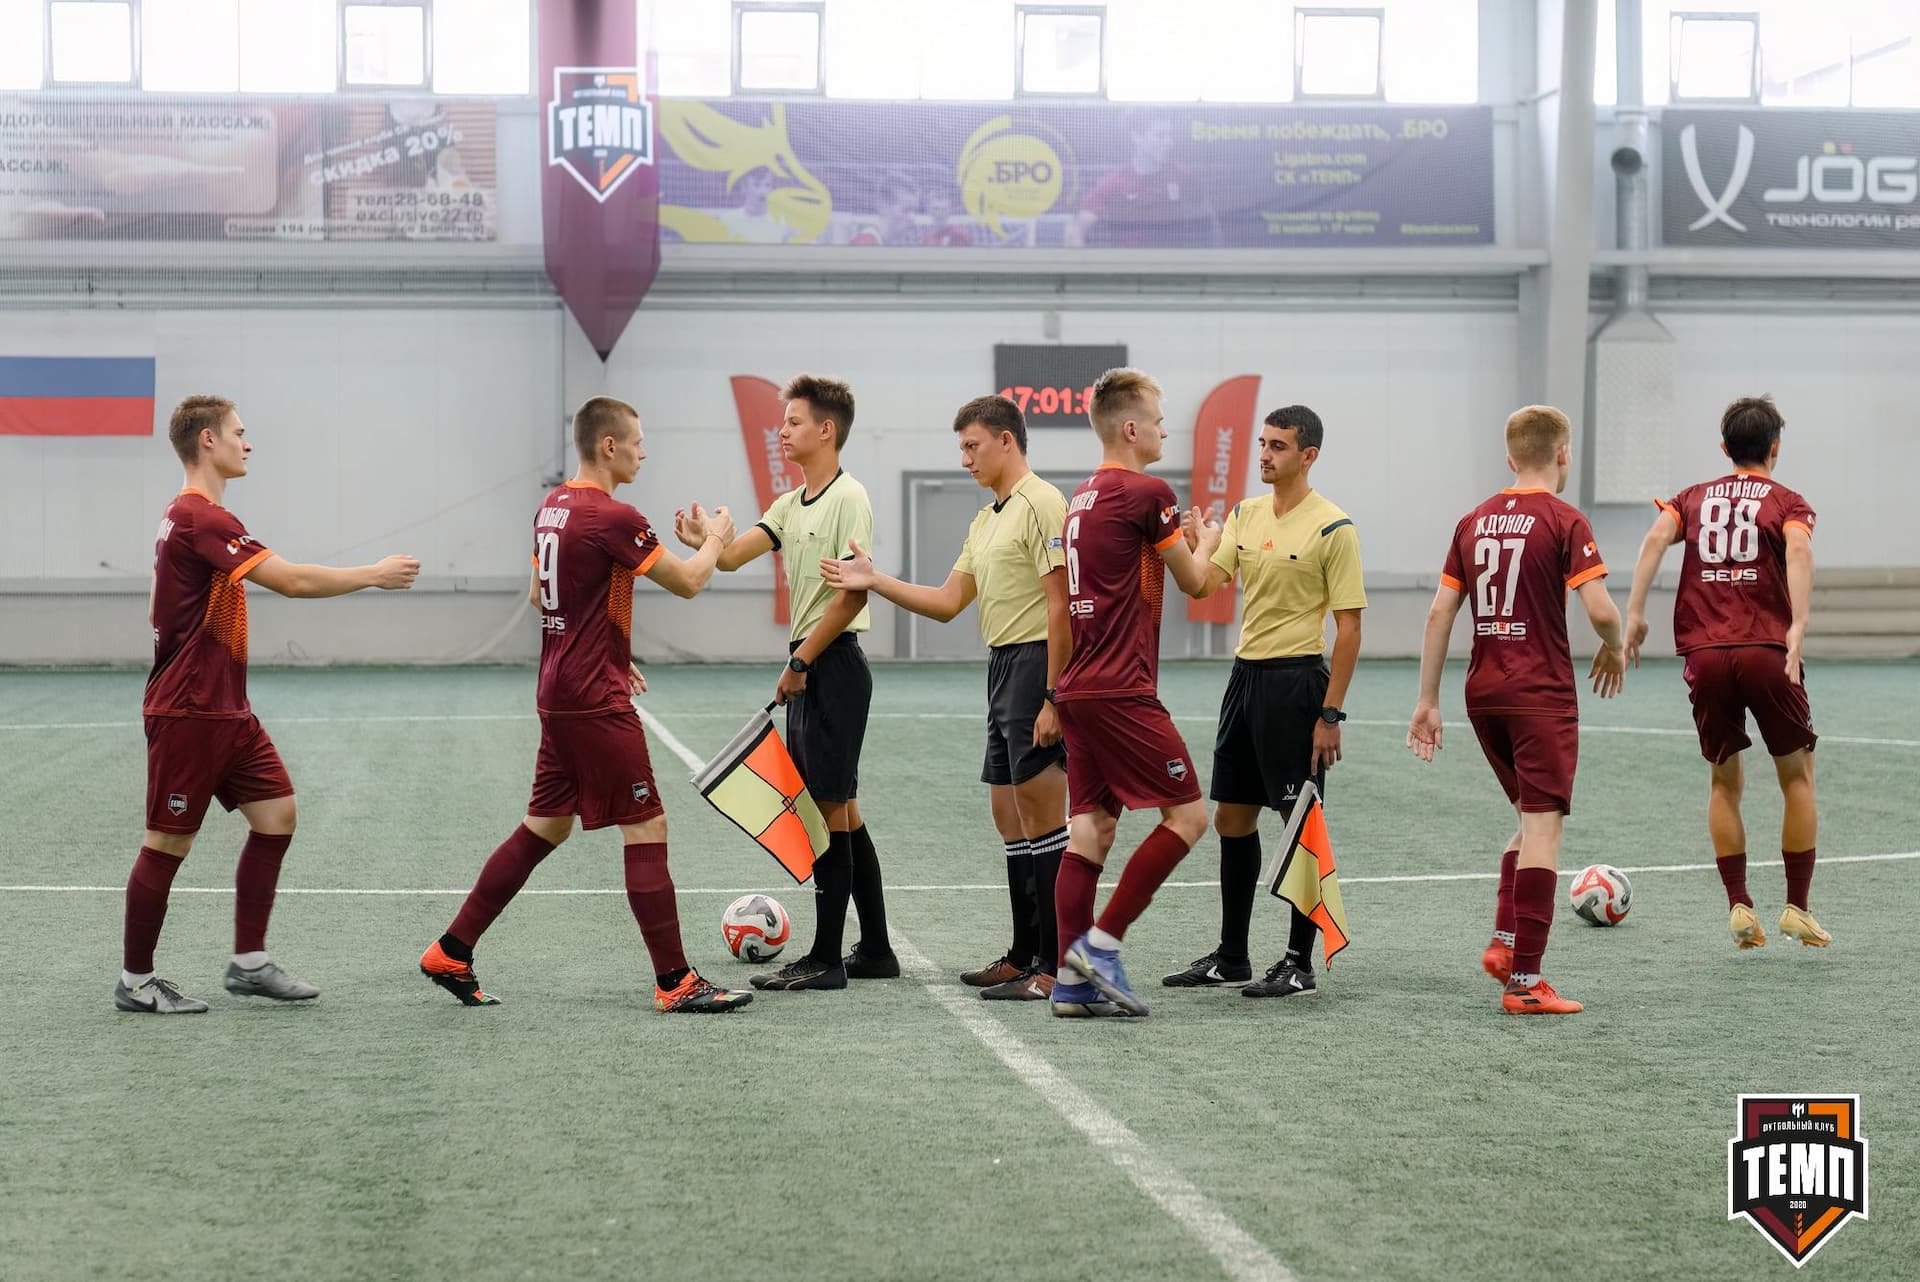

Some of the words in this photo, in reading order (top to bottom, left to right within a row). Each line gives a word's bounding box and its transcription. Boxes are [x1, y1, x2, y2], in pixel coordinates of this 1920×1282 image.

[405, 123, 464, 158] 20%
[559, 105, 642, 151] ТЕМП
[1191, 120, 1260, 142] Время
[1266, 120, 1390, 142] побеждать,
[987, 160, 1054, 184] .БРО
[1763, 141, 1920, 203] JÖG
[1208, 427, 1234, 494] Банк
[1704, 481, 1772, 500] ЛОГИНОВ
[1699, 498, 1761, 563] 88
[1474, 537, 1526, 617] 27
[1701, 568, 1758, 583] SEUS
